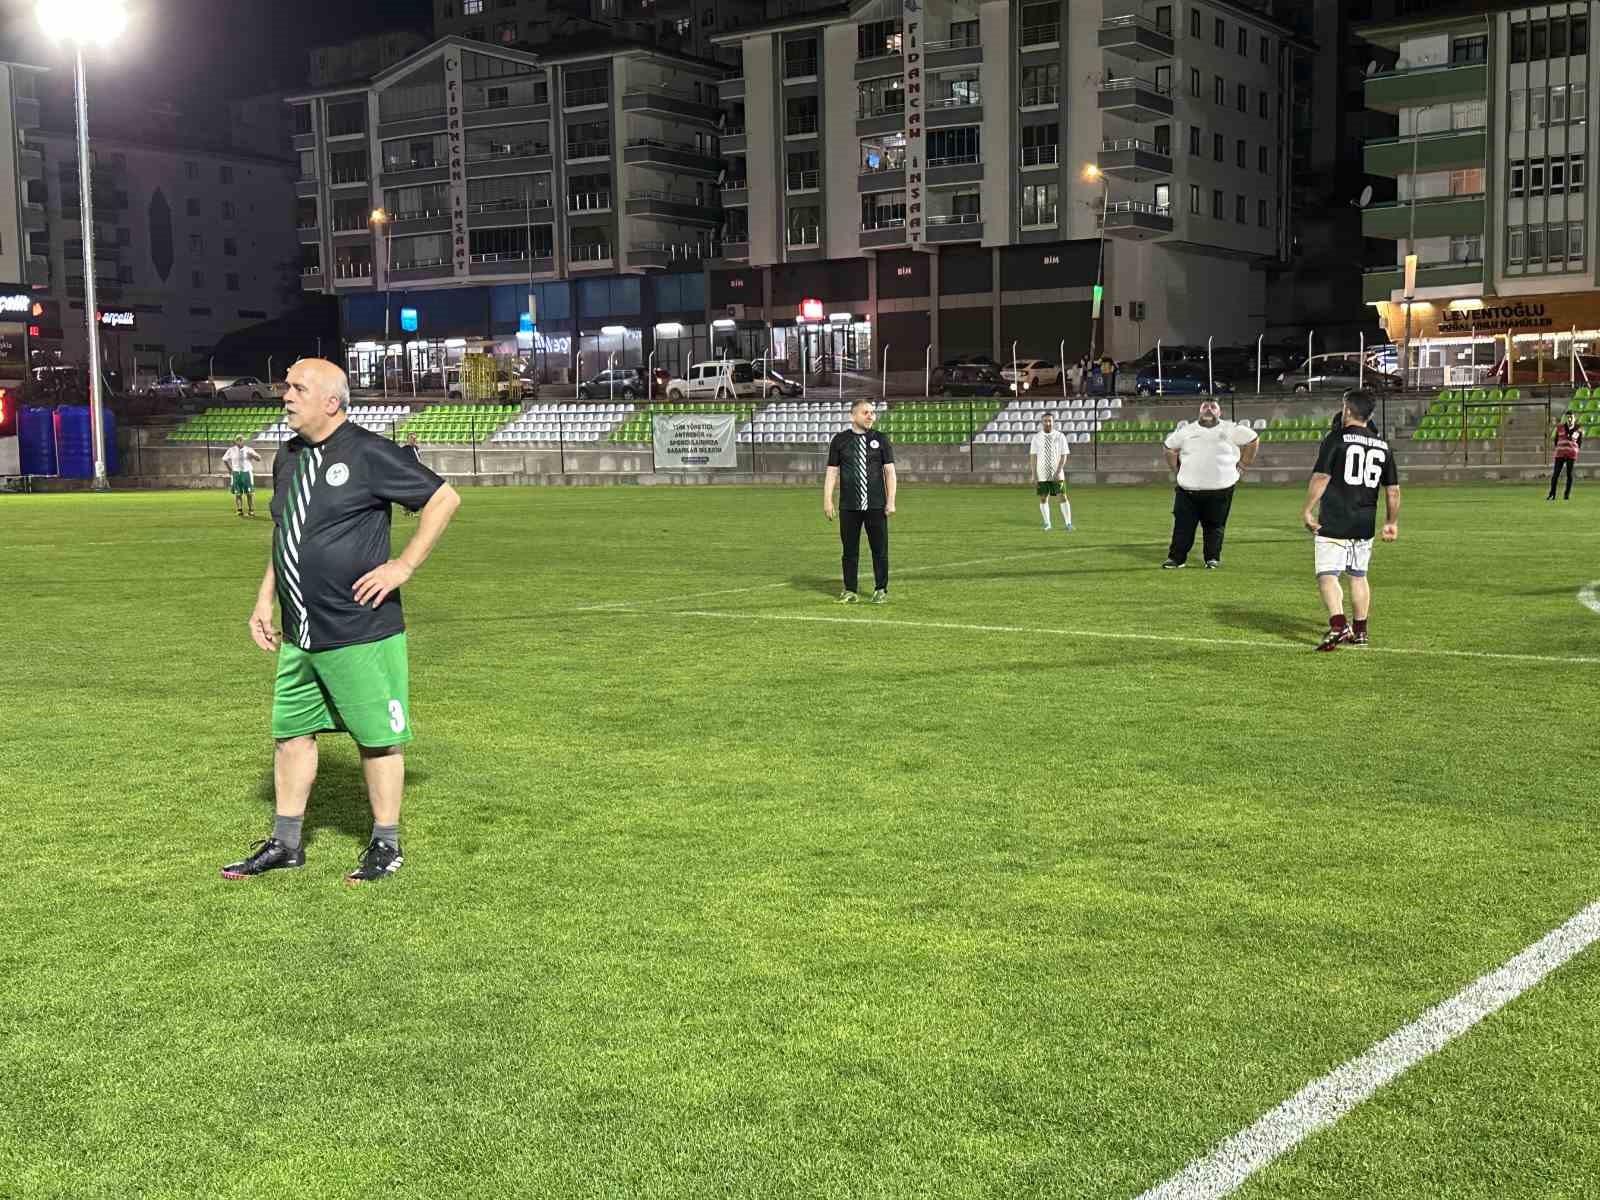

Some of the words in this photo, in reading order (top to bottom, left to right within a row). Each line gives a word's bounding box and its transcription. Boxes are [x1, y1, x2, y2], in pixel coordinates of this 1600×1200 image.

[1442, 303, 1545, 321] LEVENTOĞLU
[1344, 444, 1386, 489] 06
[388, 699, 405, 733] 3
